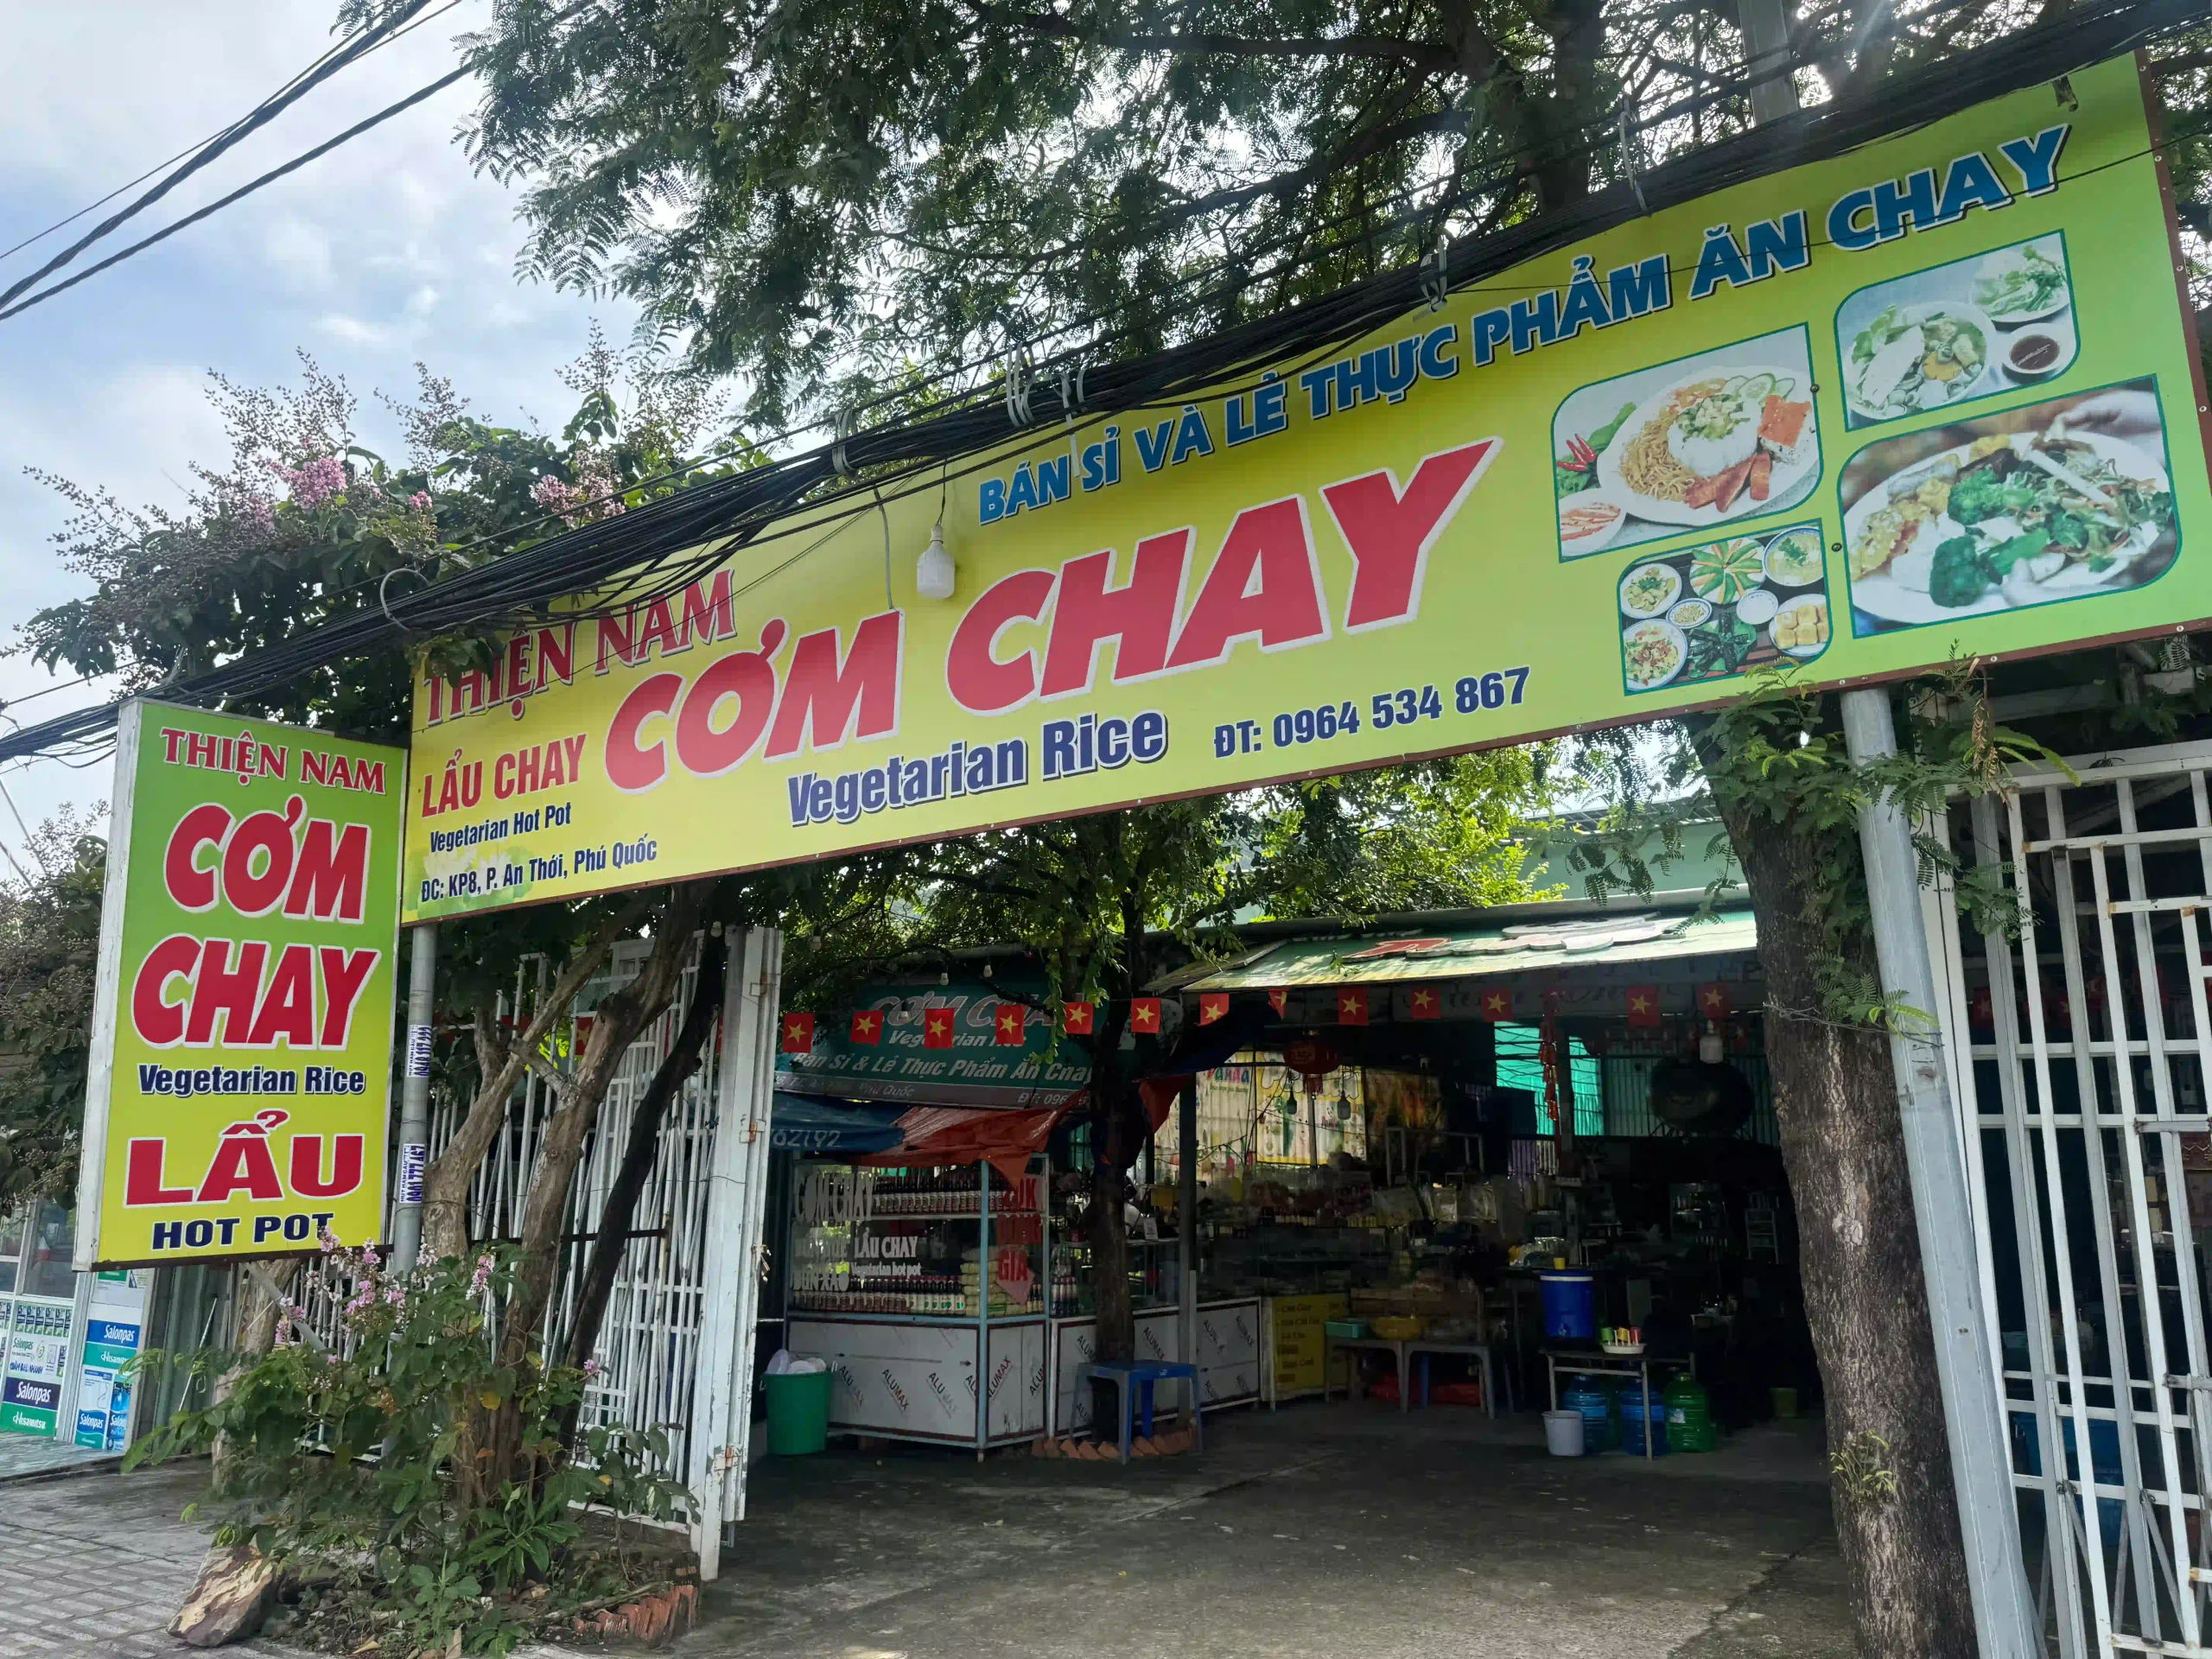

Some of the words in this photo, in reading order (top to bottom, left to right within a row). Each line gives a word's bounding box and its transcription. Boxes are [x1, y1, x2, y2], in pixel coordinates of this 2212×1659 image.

[978, 454, 1071, 526] BÁN
[1080, 425, 1121, 493] SỈ
[1134, 405, 1215, 474] VÀ
[1224, 370, 1288, 448] LẺ
[1301, 323, 1459, 421] THỰC
[1471, 253, 1673, 367] PHẨM
[1688, 208, 1811, 300] ĂN
[1826, 124, 2072, 252] CHAY
[593, 568, 737, 677] NAM
[605, 608, 905, 794] CƠM
[945, 436, 1504, 717] CHAY
[1213, 719, 1262, 759] ĐT:
[1273, 701, 1360, 748] 0964
[1371, 684, 1443, 729] 534
[1454, 665, 1530, 715] 867
[161, 727, 289, 786] THIỆN
[300, 748, 387, 795] NAM
[422, 748, 483, 818] LẨU
[494, 733, 587, 799] CHAY
[788, 737, 1028, 828] Vegetarian
[1041, 709, 1169, 782] Rice
[430, 820, 508, 853] Vegetarian
[513, 809, 540, 836] Hot
[545, 802, 572, 829] Pot
[163, 793, 371, 925] CƠM
[421, 878, 444, 903] ĐC:
[448, 872, 481, 897] KP8,
[486, 867, 498, 890] P.
[503, 863, 523, 887] An
[529, 854, 568, 882] Thới,
[575, 845, 607, 874] Phú
[612, 833, 657, 869] Quốc
[131, 932, 381, 1051] CHAY
[888, 1029, 986, 1047] Vegrian
[137, 1063, 297, 1097] Vegetarian
[304, 1065, 366, 1095] Rice
[852, 1056, 870, 1071] &
[871, 1055, 899, 1073] Lẻ
[899, 1058, 946, 1078] Thực
[948, 1057, 1008, 1079] Phẩm
[1044, 1094, 1071, 1106] 096
[124, 1108, 365, 1208] LẨU
[152, 1217, 240, 1250] HOT
[253, 1213, 334, 1243] POT
[881, 1236, 918, 1258] CHAY
[100, 1350, 130, 1364] Hisami
[104, 1325, 136, 1344] Salonpas
[16, 1381, 52, 1405] Salonpas
[882, 1369, 910, 1411] ALUMAX
[79, 1413, 104, 1429] Salonpas
[110, 1414, 127, 1430] Salon
